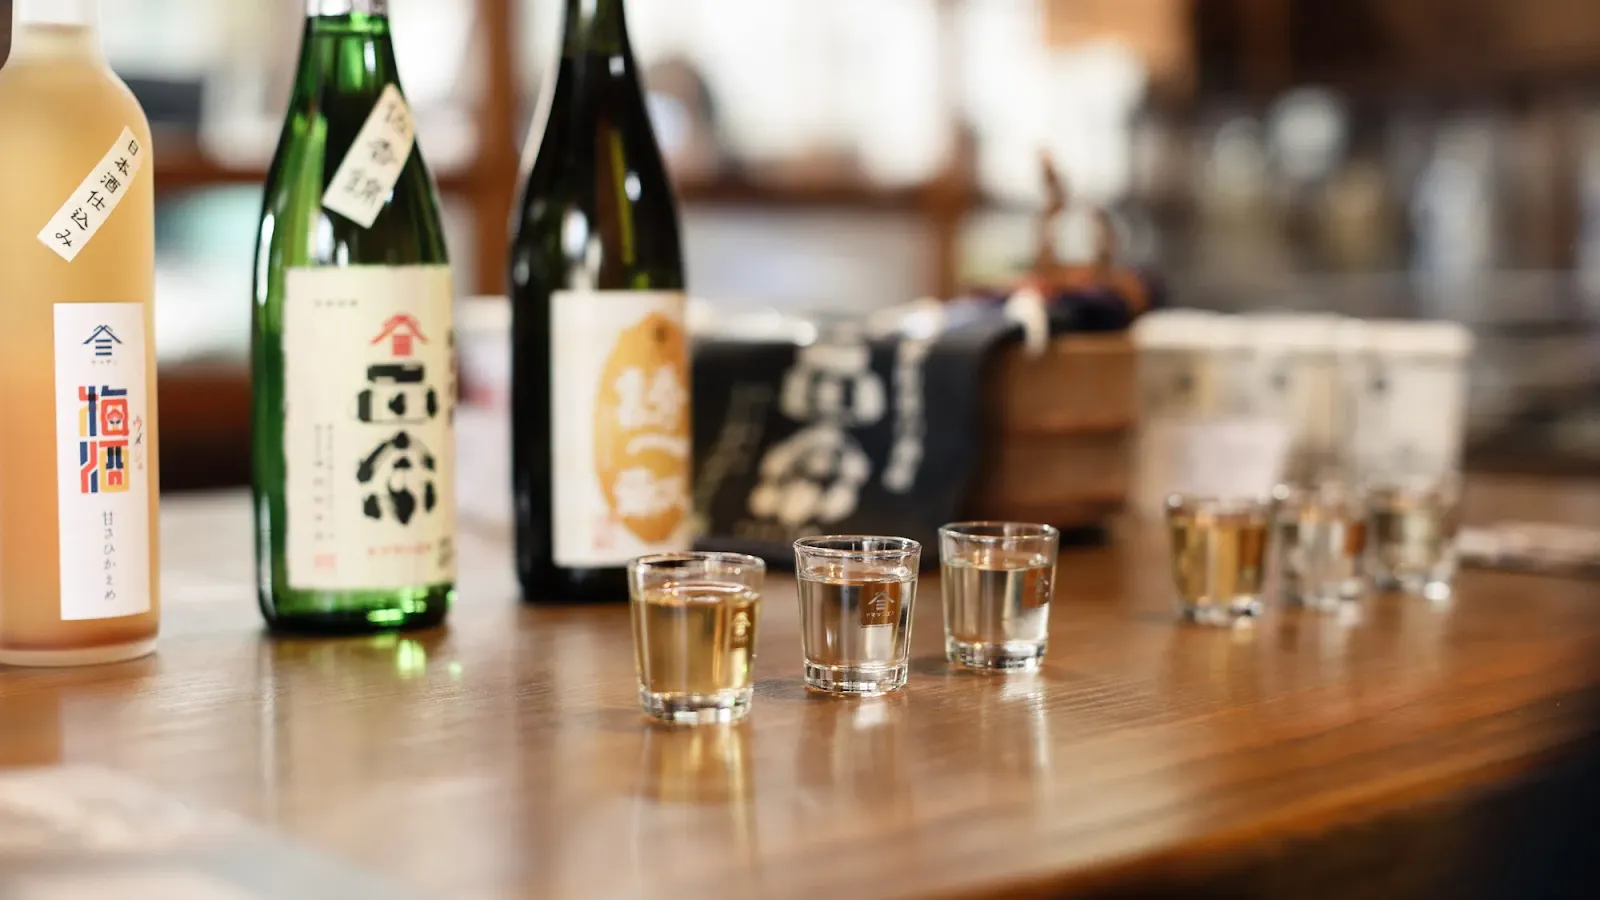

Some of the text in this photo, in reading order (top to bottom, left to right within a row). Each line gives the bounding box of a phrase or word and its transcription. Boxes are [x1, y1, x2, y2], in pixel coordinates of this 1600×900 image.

[55, 139, 140, 248] 日本酒仕込み
[78, 385, 130, 494] 梅酒
[101, 510, 117, 601] 甘さひかえめ
